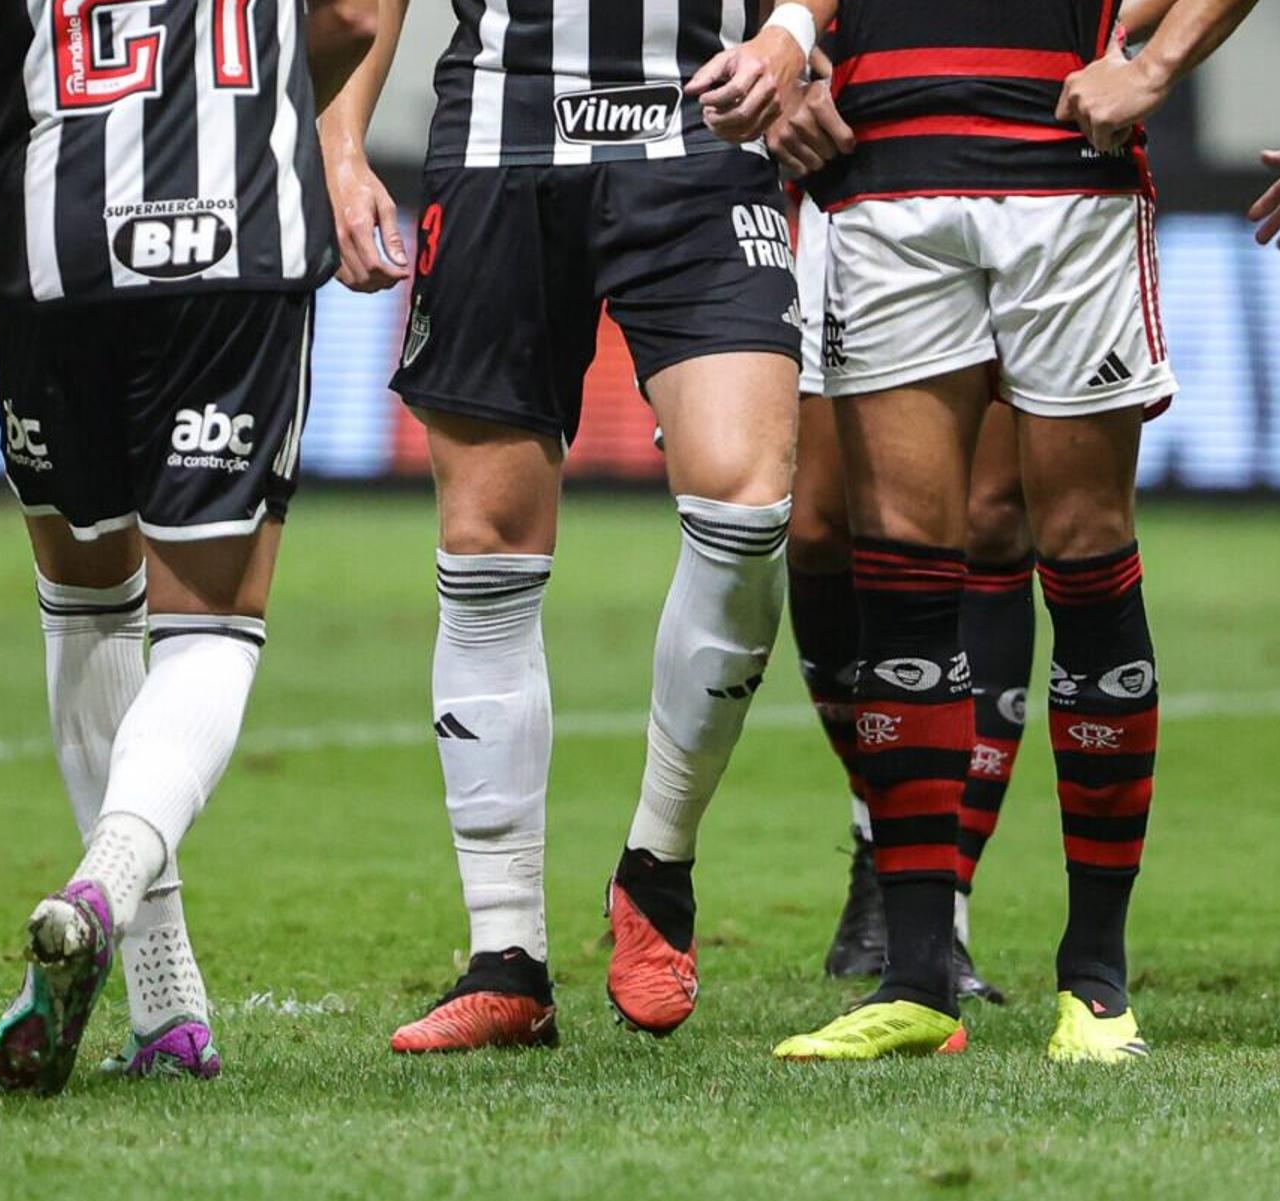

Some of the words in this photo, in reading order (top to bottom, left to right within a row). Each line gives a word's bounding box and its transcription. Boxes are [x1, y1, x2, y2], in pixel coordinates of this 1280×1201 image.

[560, 97, 668, 135] Vilma
[105, 199, 237, 218] SUPERMERCADOS
[131, 214, 219, 269] BH
[419, 202, 444, 277] 3
[171, 403, 255, 456] abc
[167, 452, 182, 467] da
